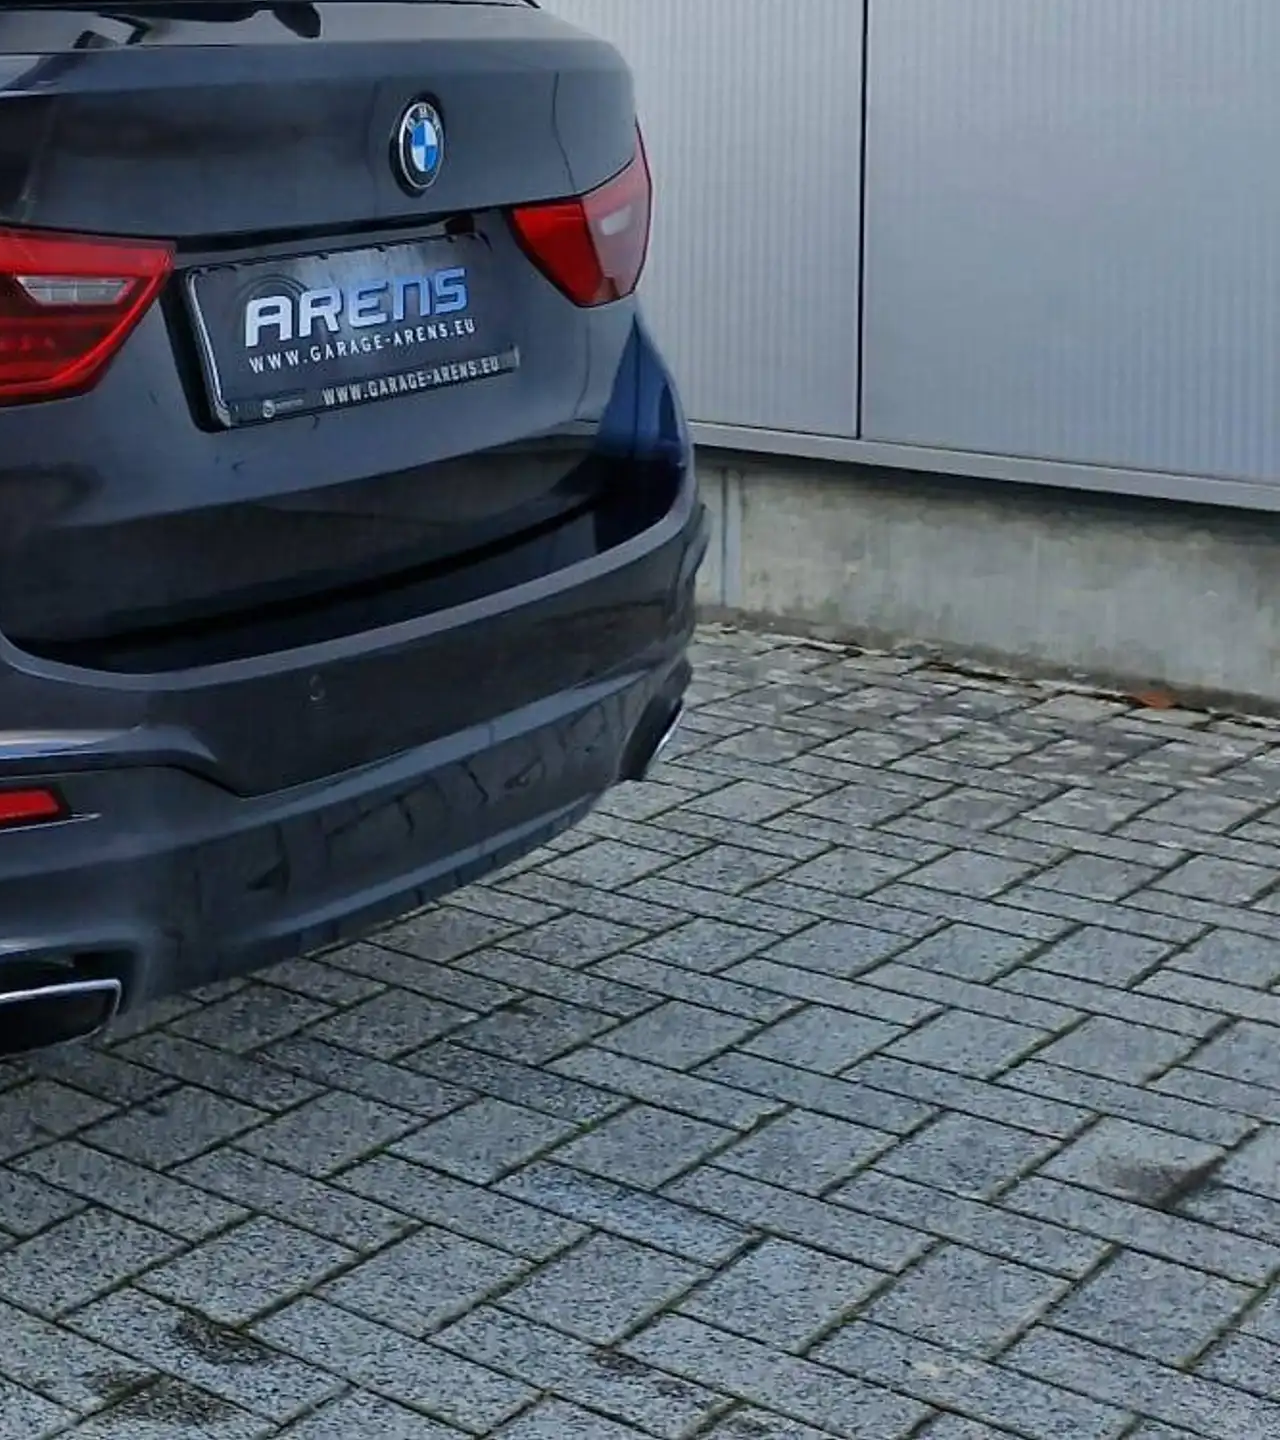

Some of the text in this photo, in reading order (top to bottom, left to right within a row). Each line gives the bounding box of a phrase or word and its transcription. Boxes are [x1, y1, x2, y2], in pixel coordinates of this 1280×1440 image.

[244, 266, 469, 348] ARENS
[248, 317, 477, 375] WWW.GARAGE-ARENS.EU
[322, 356, 501, 407] WWW.GARAGE-ARENS.EU
